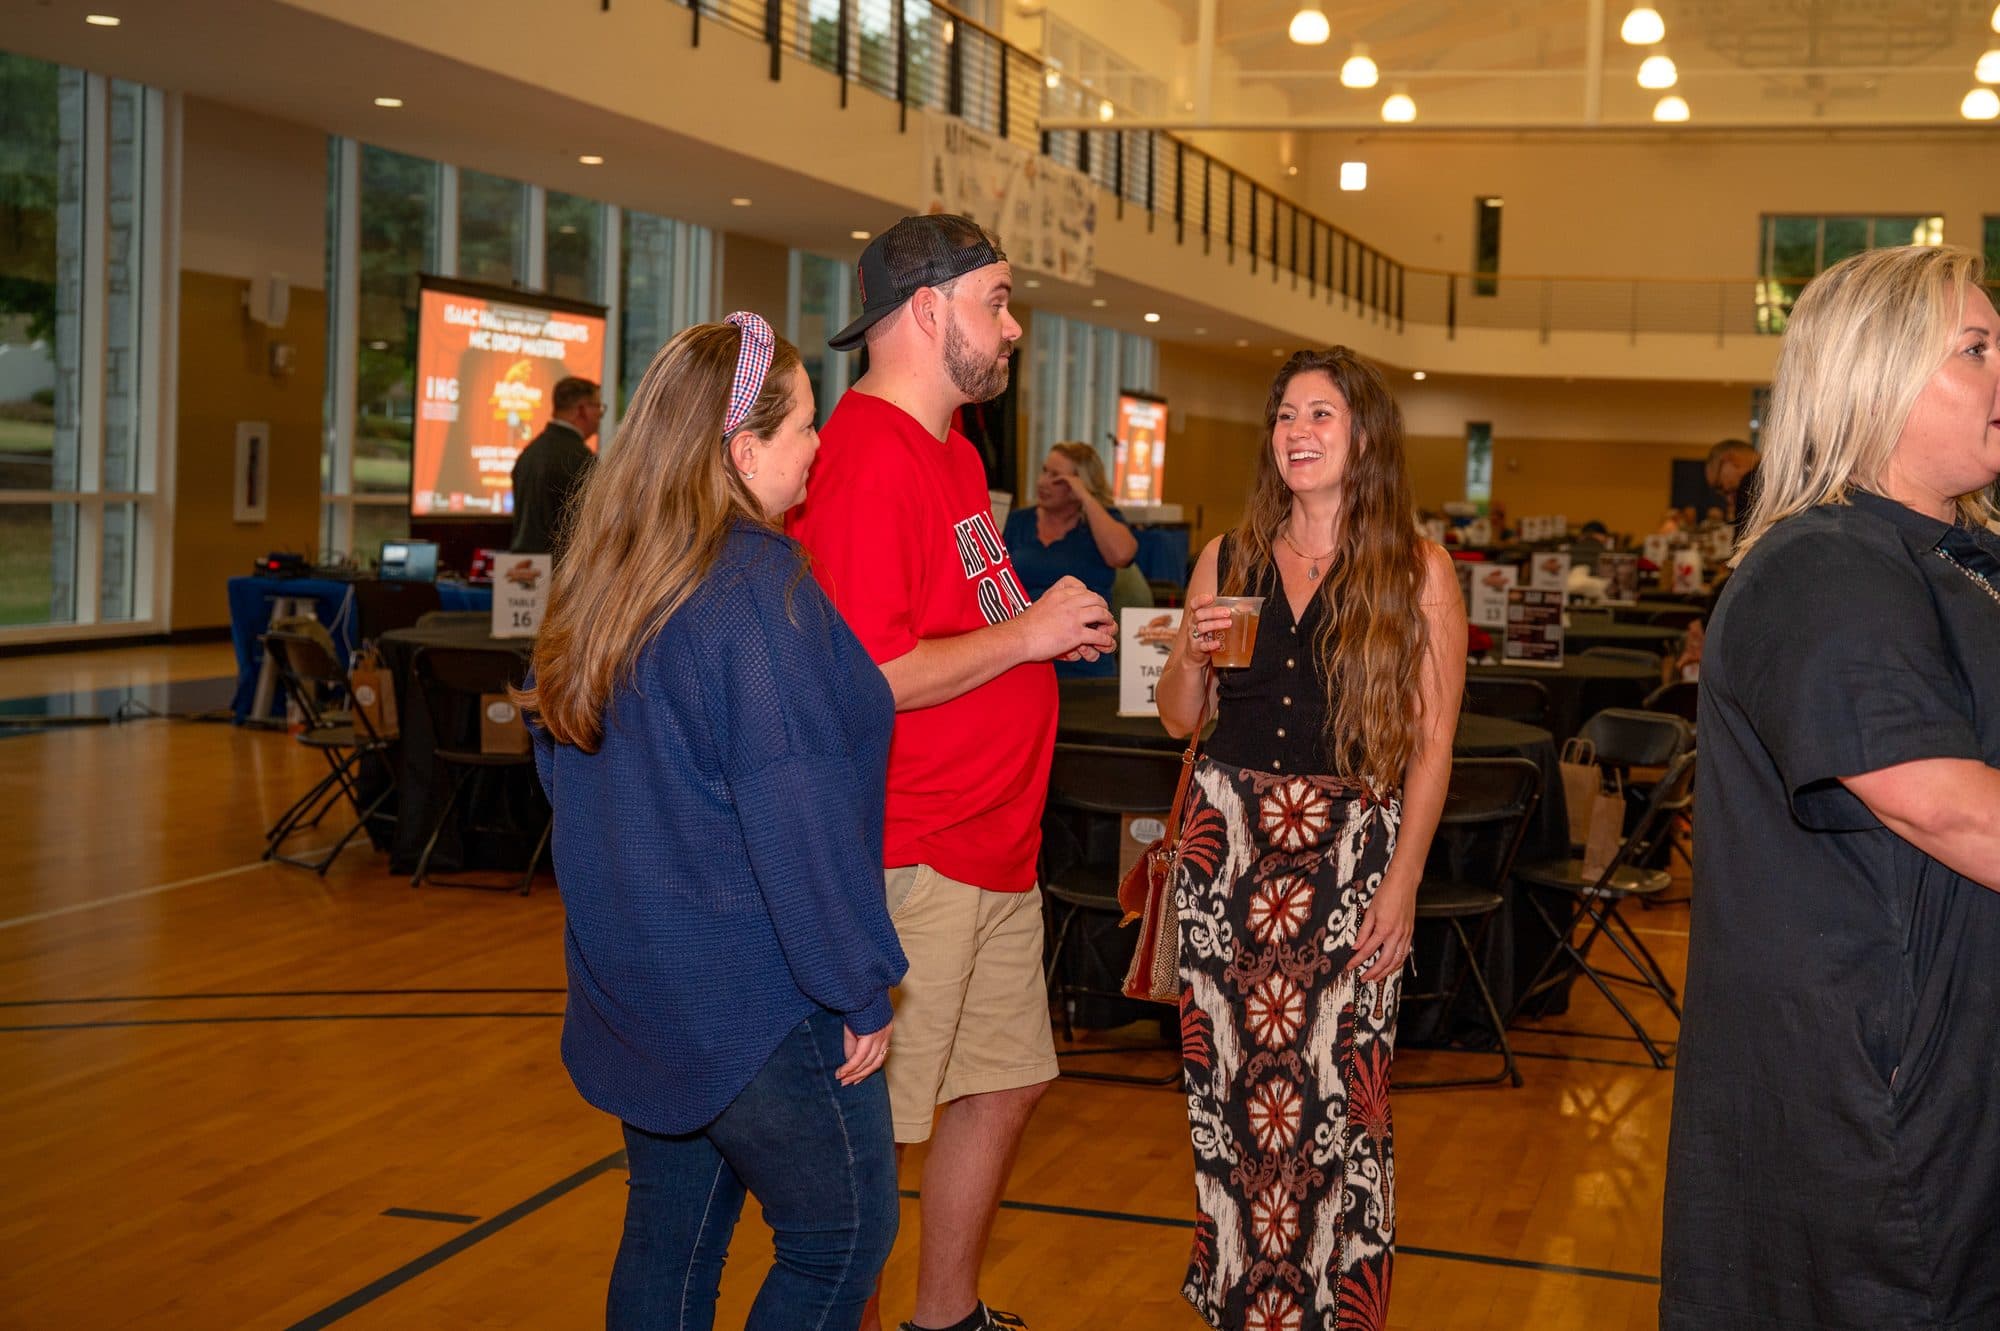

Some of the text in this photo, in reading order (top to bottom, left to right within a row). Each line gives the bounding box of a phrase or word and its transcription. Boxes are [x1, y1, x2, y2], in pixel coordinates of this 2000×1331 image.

[512, 610, 532, 627] 16
[1140, 665, 1163, 677] TAB
[1146, 683, 1155, 703] 1
